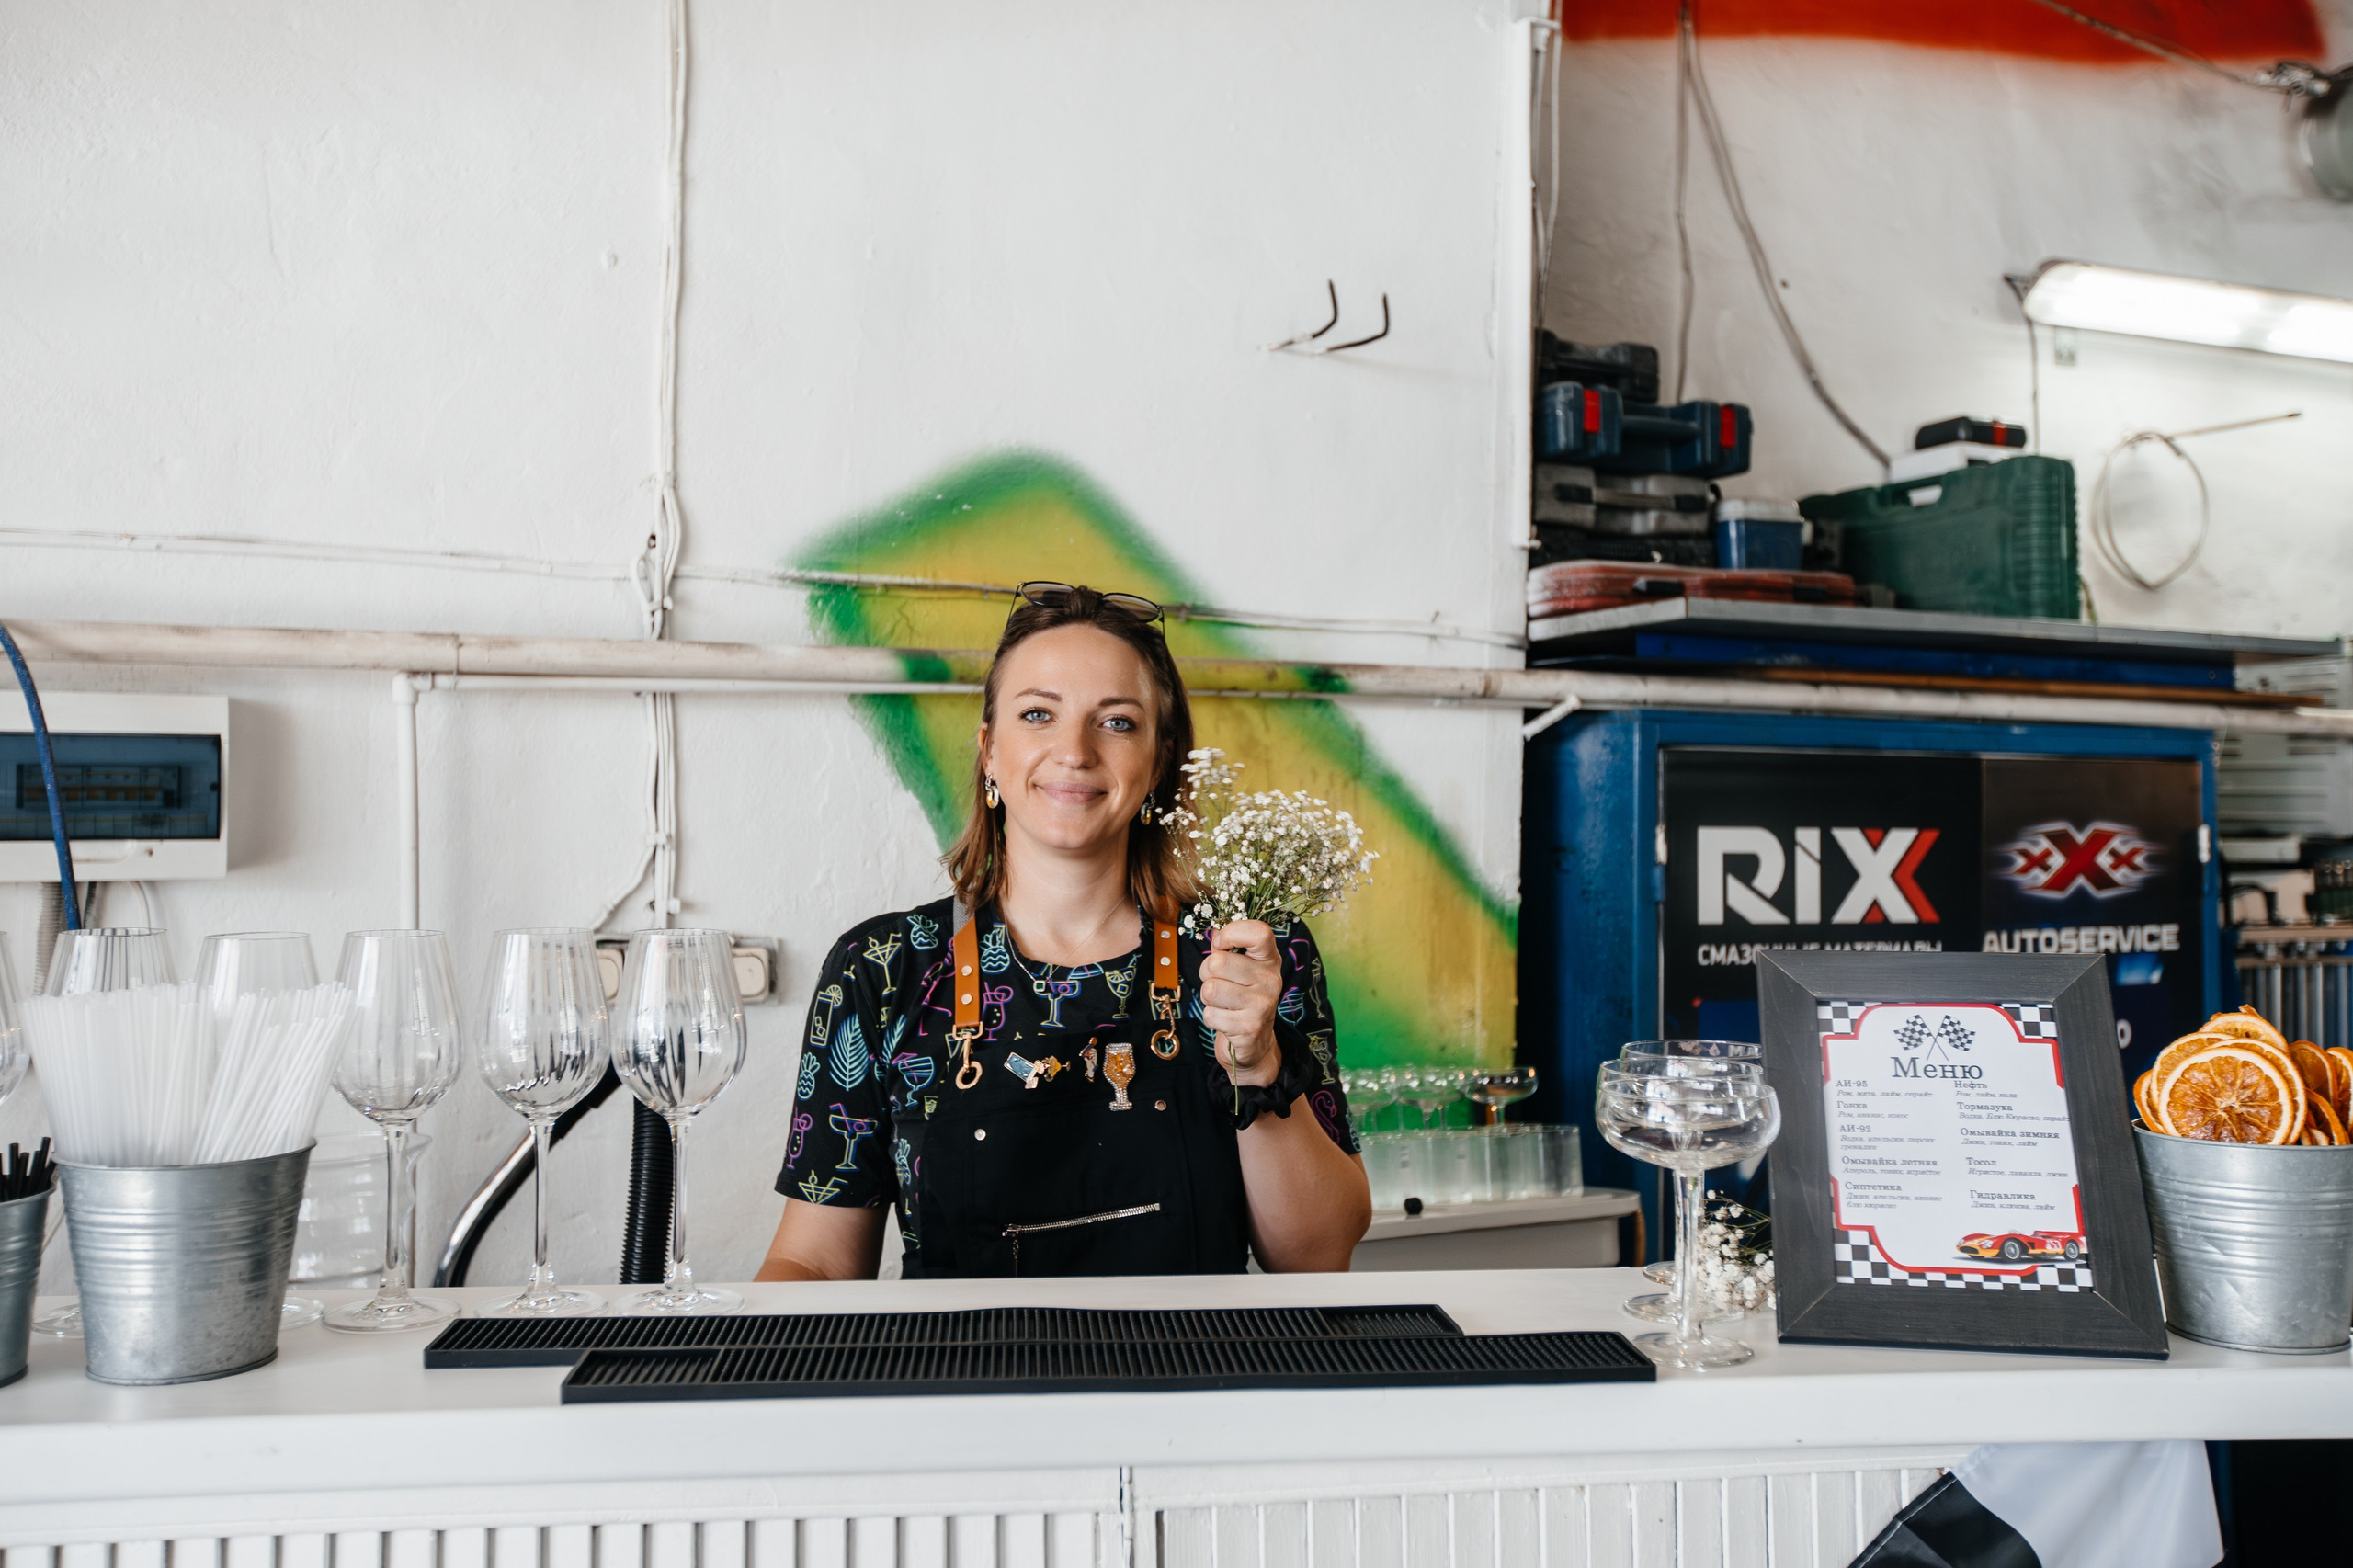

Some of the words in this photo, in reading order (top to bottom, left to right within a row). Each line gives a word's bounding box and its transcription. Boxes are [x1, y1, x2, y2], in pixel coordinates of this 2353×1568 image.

[1698, 827, 1940, 924] RIX
[1982, 923, 2180, 953] AUTOSERVICE
[1890, 1057, 1983, 1079] Меню
[1954, 1081, 1987, 1090] Нефть
[1961, 1128, 2017, 1138] Омывайка
[1842, 1156, 1897, 1165] Омывайка
[1966, 1157, 1996, 1165] Тосол
[1845, 1182, 1902, 1191] Синтетика
[1970, 1190, 2036, 1200] Гидравлика
